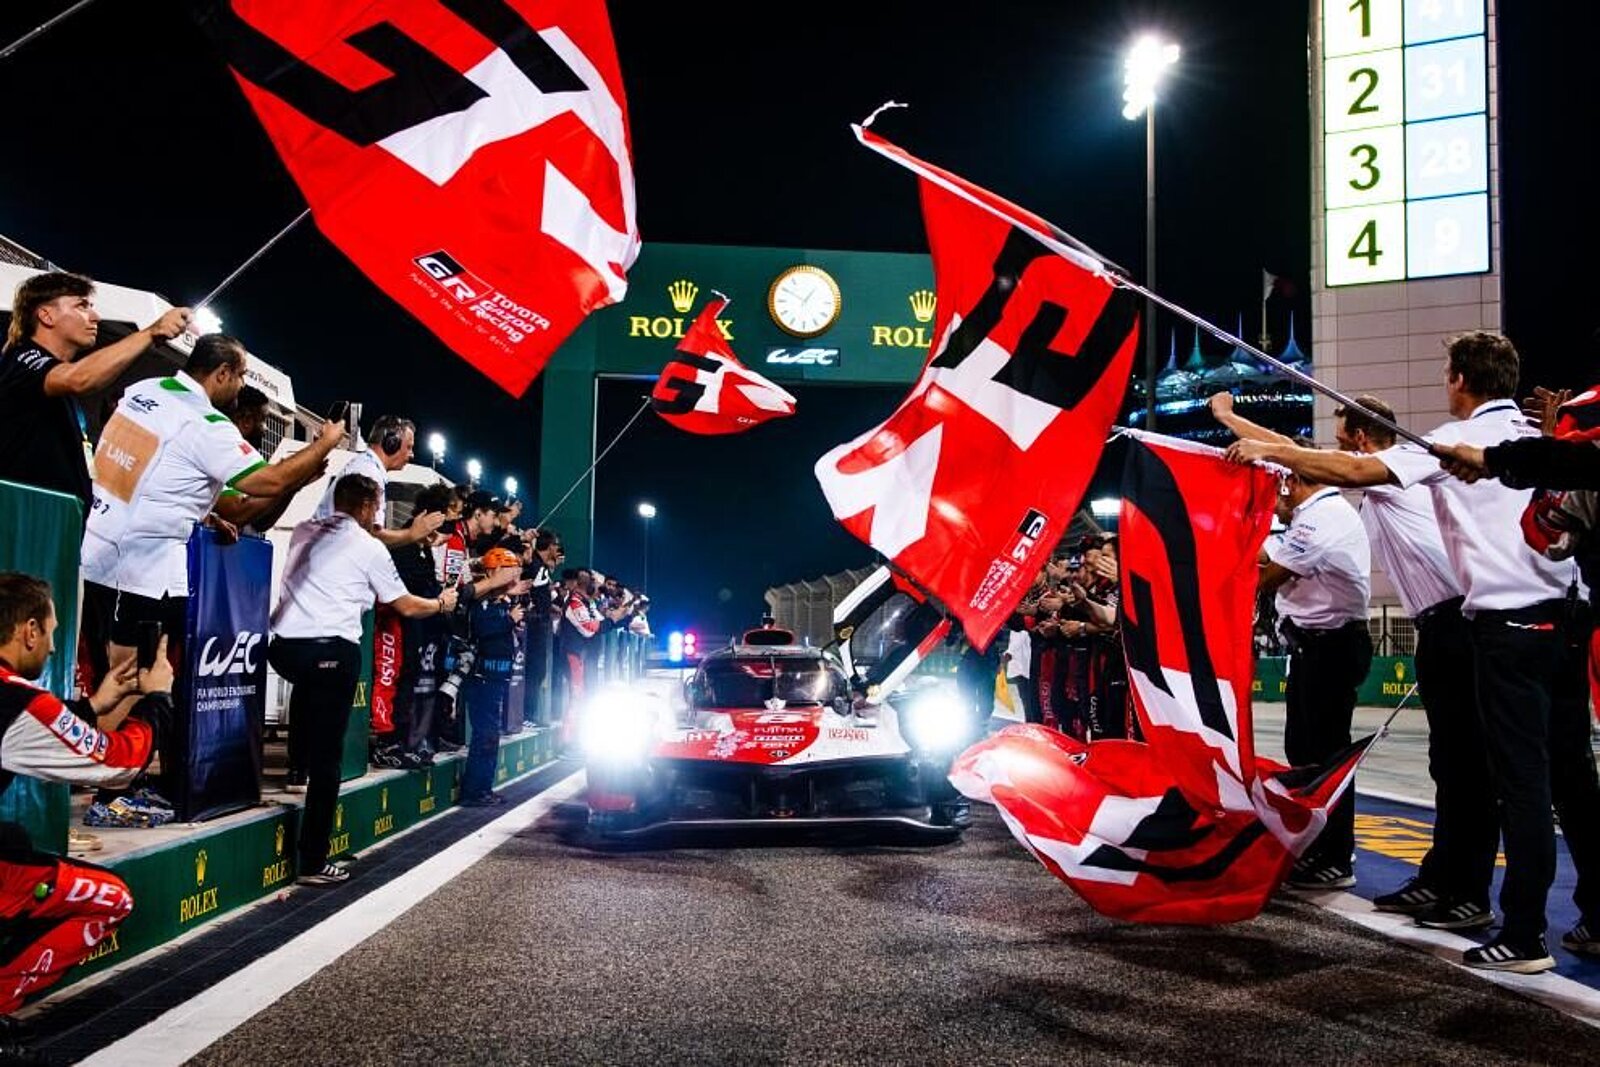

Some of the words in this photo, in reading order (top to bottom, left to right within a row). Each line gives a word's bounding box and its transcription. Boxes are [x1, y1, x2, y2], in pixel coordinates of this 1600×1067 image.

[1348, 0, 1371, 37] 1
[1347, 67, 1380, 115] 2
[1421, 60, 1468, 100] 31
[1348, 144, 1381, 191] 3
[1420, 136, 1472, 179] 28
[1347, 219, 1383, 266] 4
[418, 256, 477, 302] GR
[492, 291, 550, 331] TOYOTA
[629, 315, 734, 341] ROLX
[766, 348, 839, 365] WEC
[872, 326, 933, 348] ROL
[198, 630, 263, 677] WEC
[380, 632, 395, 687] DENSO
[263, 860, 288, 888] ROLE
[180, 887, 218, 923] ROLEX
